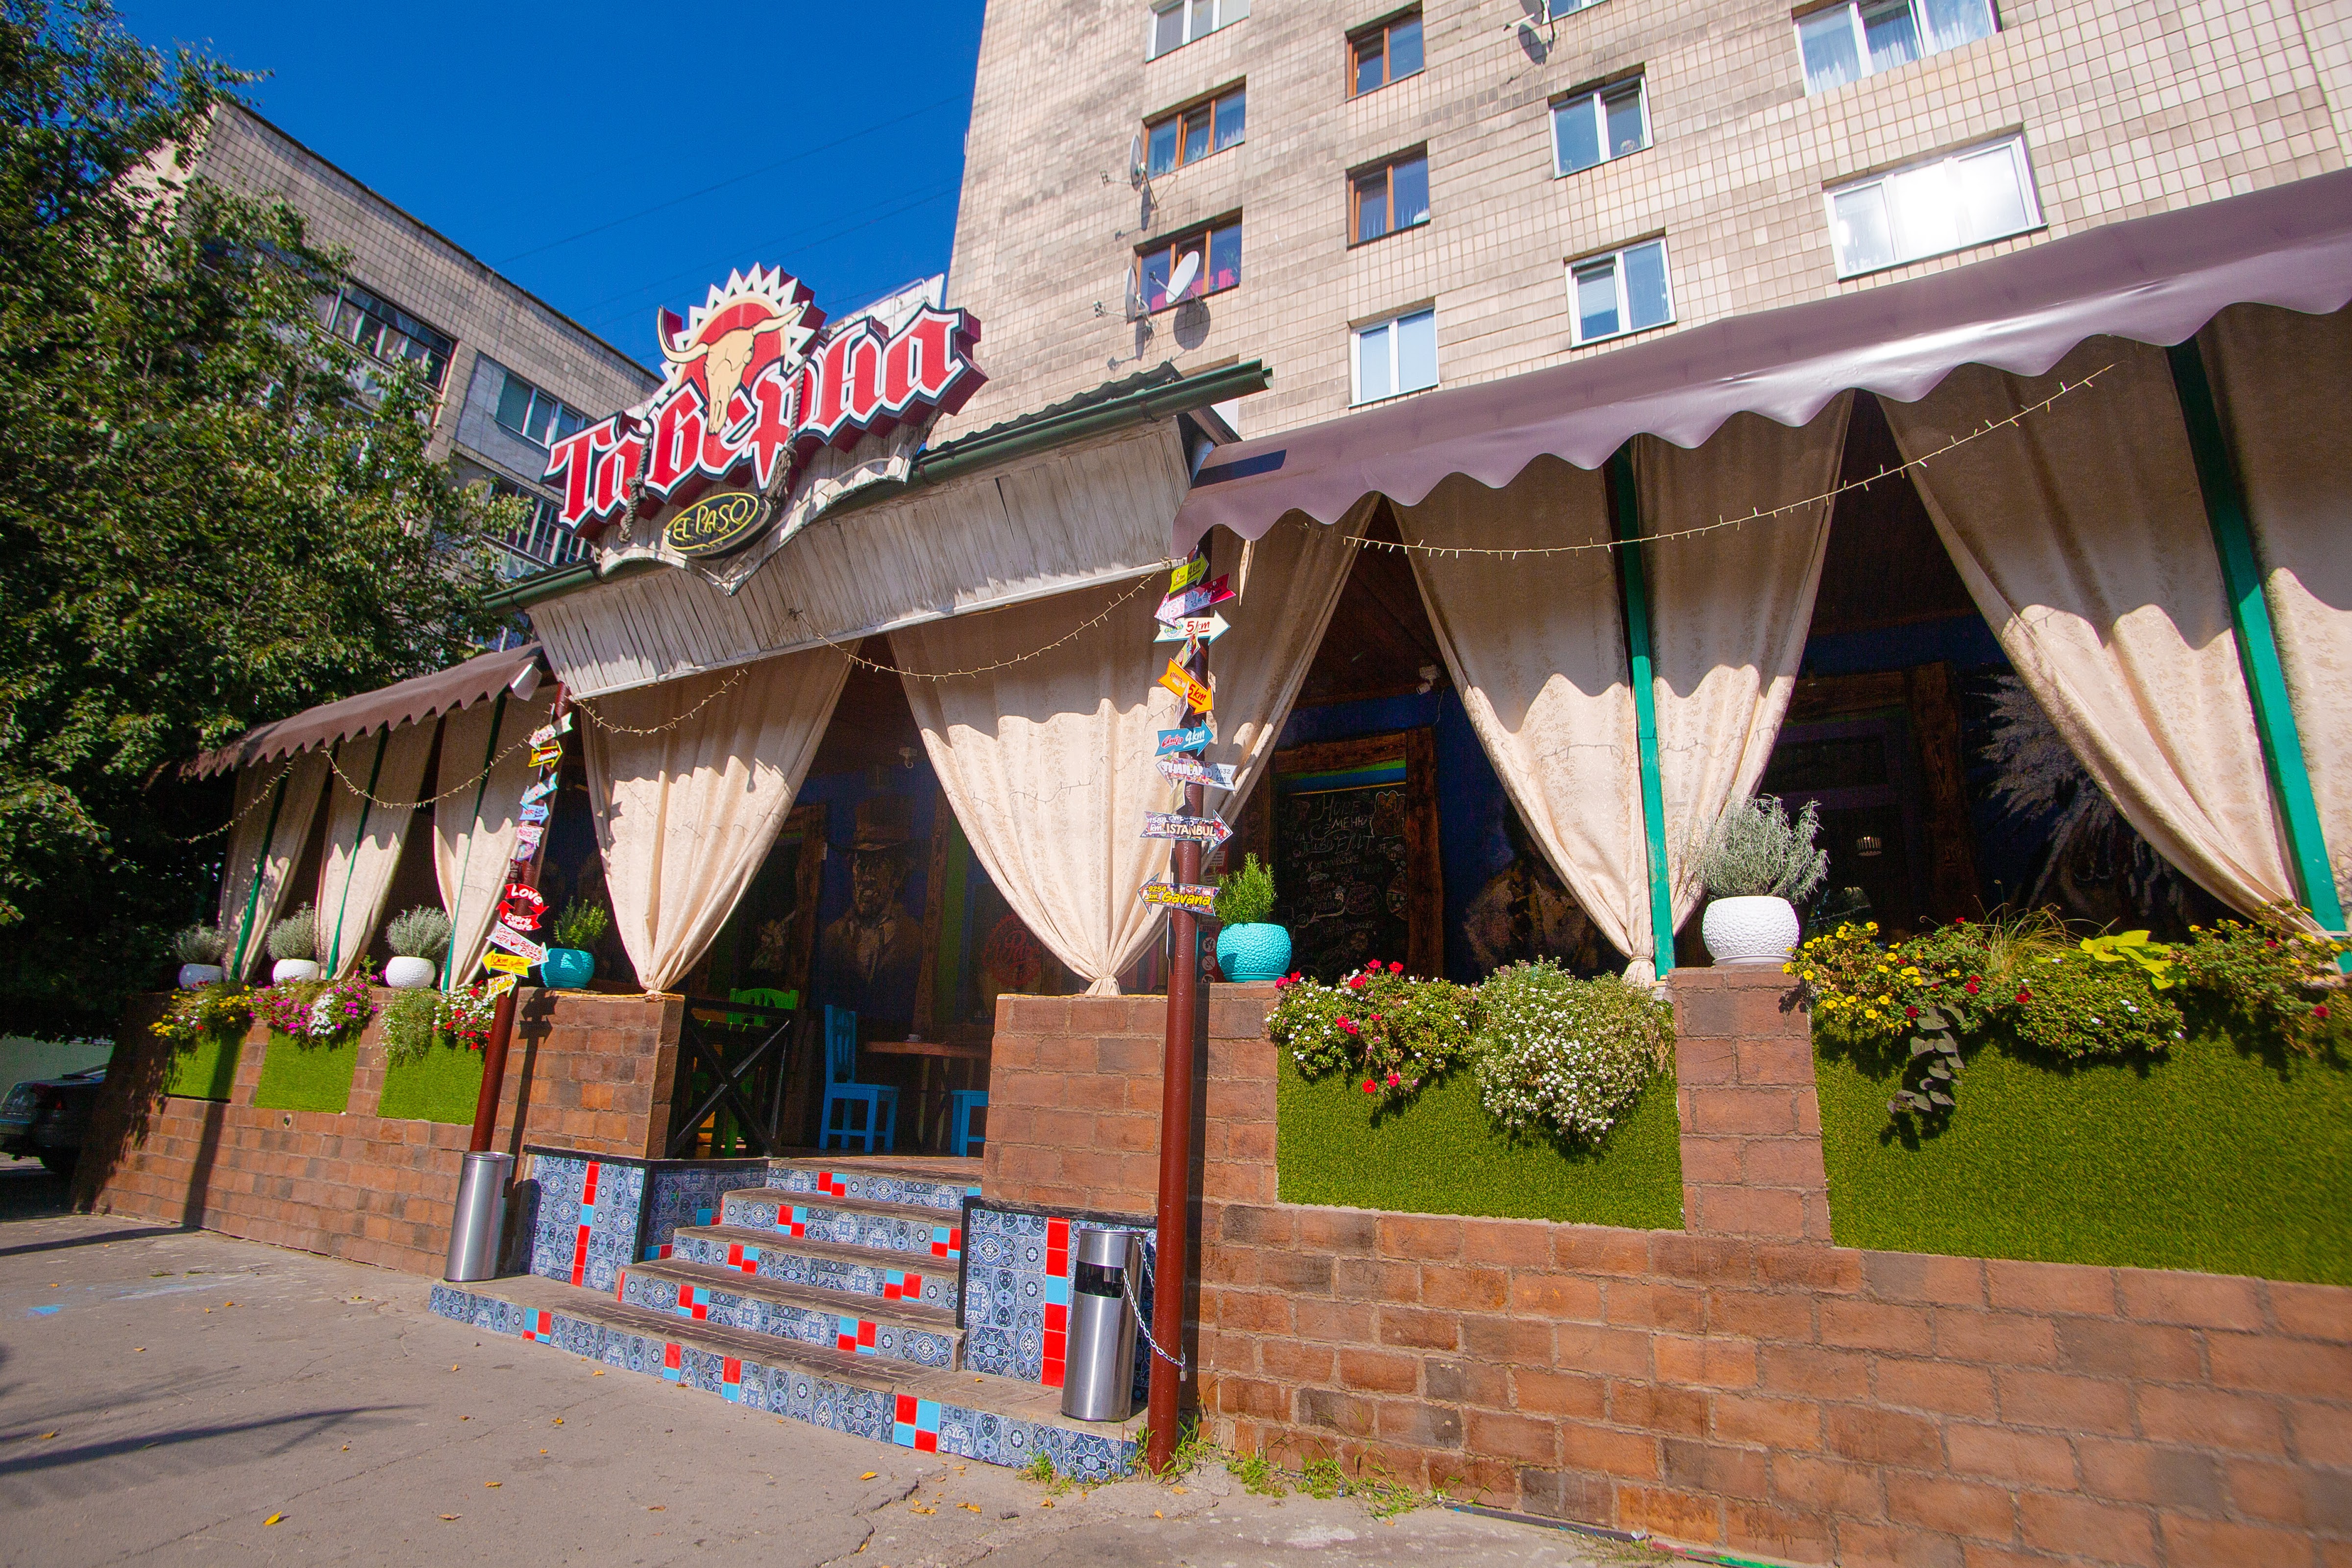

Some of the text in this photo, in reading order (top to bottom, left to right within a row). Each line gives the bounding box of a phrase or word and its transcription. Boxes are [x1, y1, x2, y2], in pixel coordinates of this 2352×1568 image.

[696, 498, 748, 536] PASO
[1185, 730, 1205, 744] 4km
[1162, 760, 1214, 778] THAILAND
[1216, 774, 1226, 783] km
[1166, 823, 1217, 837] ISTANBUL
[1161, 891, 1212, 906] Gavana
